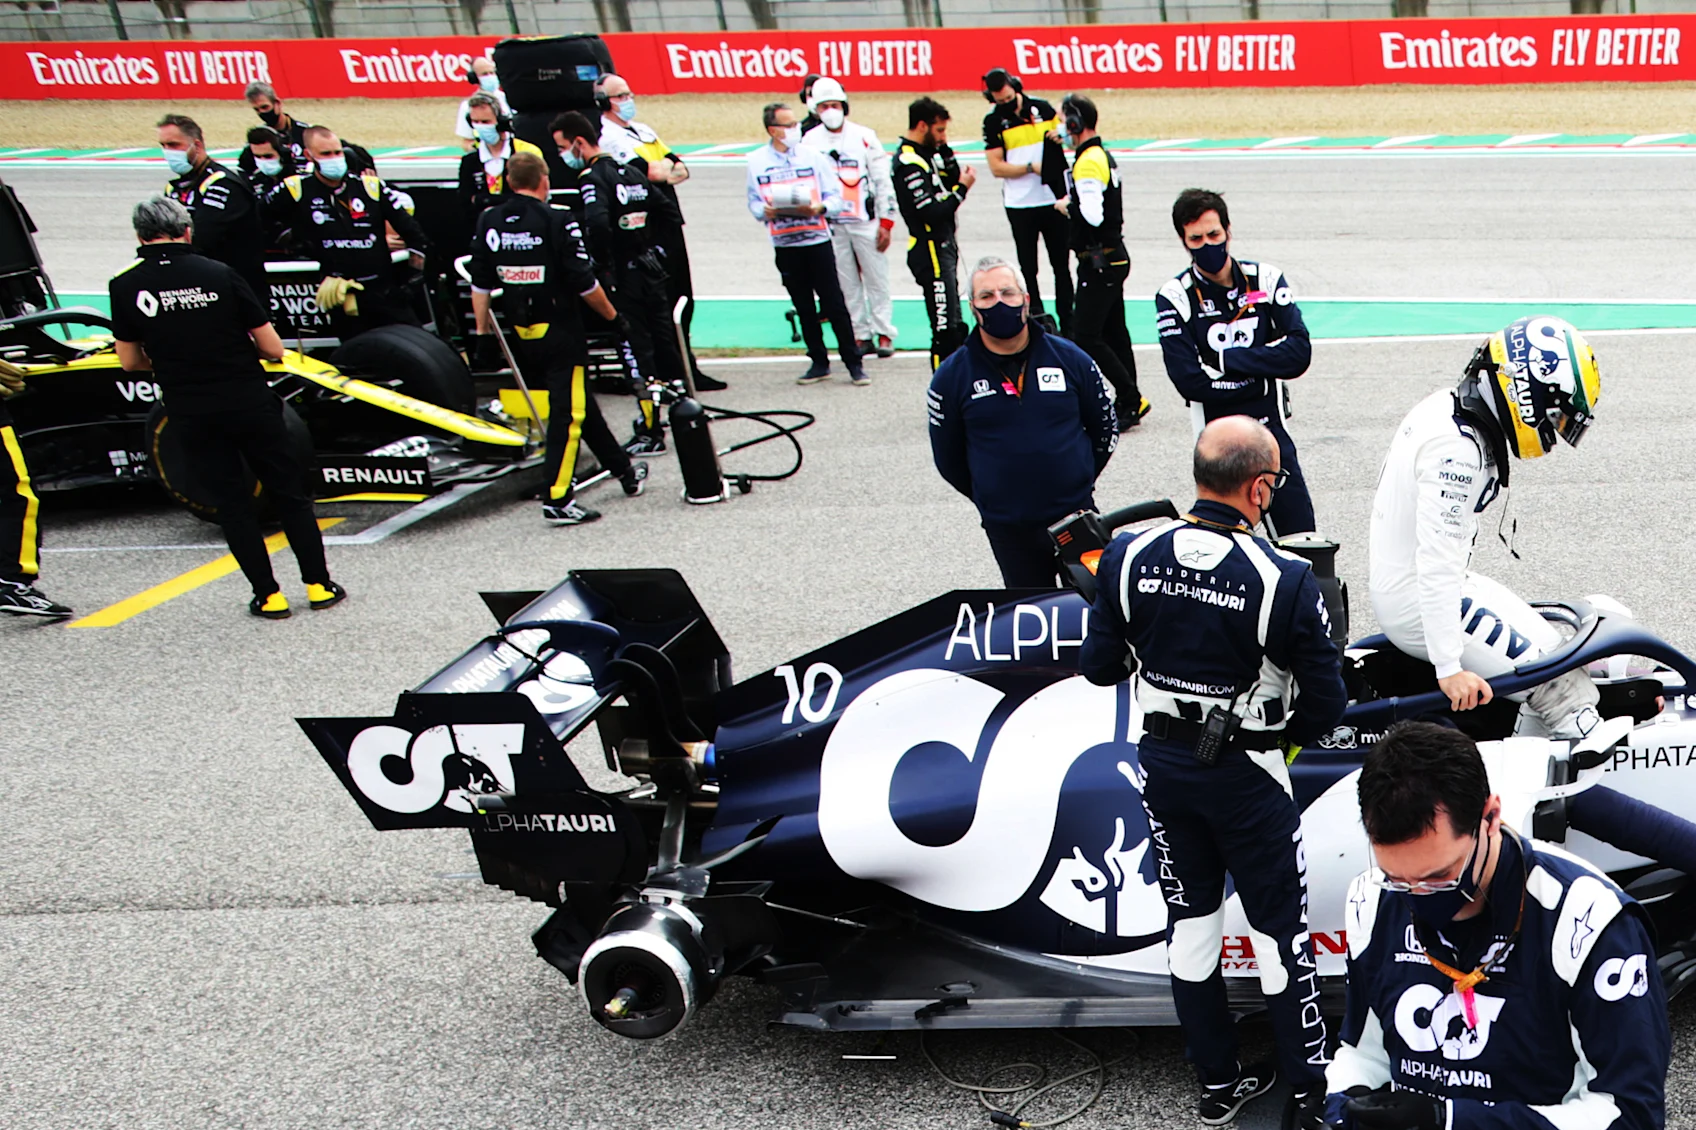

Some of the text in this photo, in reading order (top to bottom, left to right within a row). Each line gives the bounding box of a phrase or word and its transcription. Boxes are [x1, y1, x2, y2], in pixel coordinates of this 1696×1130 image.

[339, 48, 487, 84] Emirates
[666, 40, 933, 79] Emirates FLY BETTER
[1013, 34, 1297, 75] Emirates FLY BETTER
[1380, 28, 1681, 70] Emirates FLY BETTER
[27, 51, 271, 86] Emirates FLY BETTER
[505, 267, 541, 281] Castrol
[1509, 325, 1537, 424] ALPHATAURI
[322, 466, 426, 486] RENAULT
[1140, 565, 1247, 592] SCUDERIA
[1161, 580, 1246, 612] ALPHATAURI
[775, 662, 844, 724] 10
[1146, 670, 1236, 695] ALPHATAURI.COM
[473, 815, 617, 832] LPHATAURI
